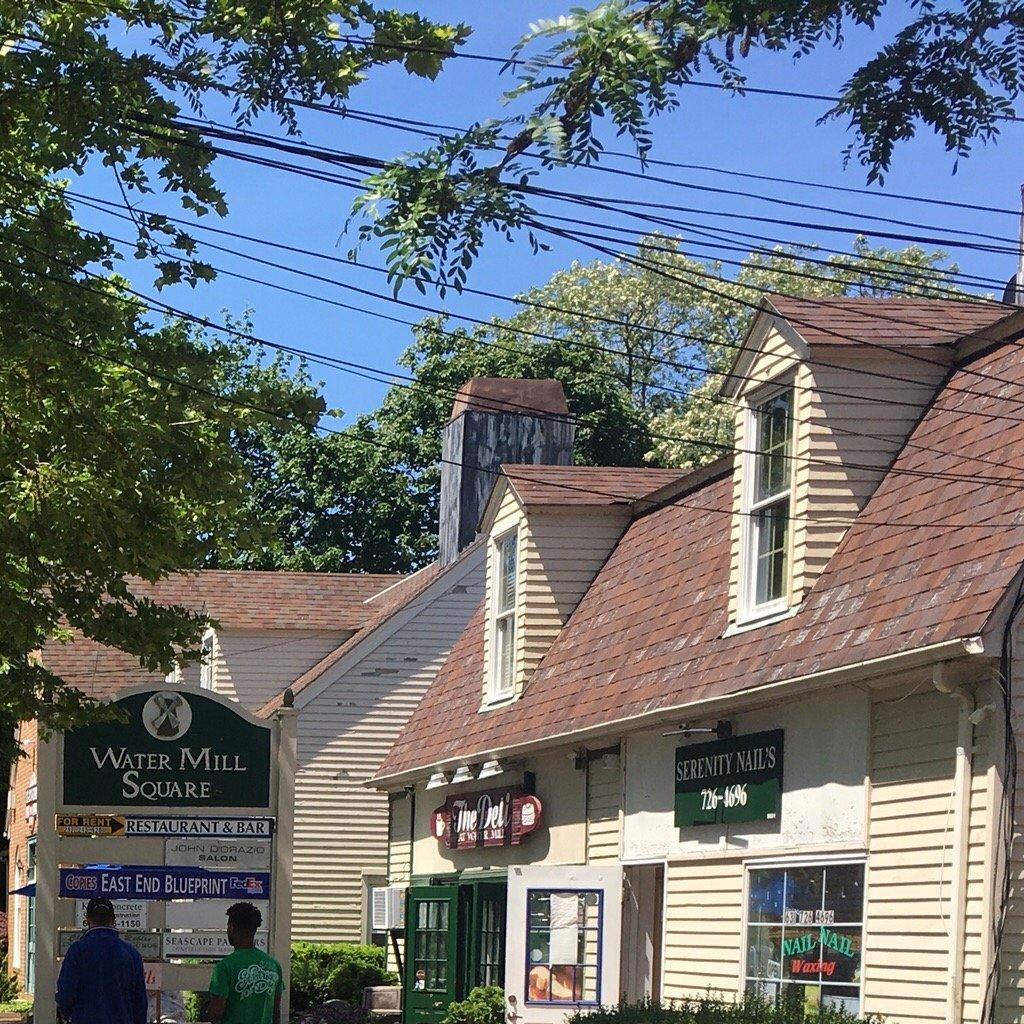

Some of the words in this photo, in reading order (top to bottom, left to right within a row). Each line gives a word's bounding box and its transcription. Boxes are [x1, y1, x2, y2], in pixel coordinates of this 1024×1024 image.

[89, 747, 173, 770] WATER
[179, 747, 247, 771] MILL
[677, 752, 733, 782] SERENITY
[735, 745, 776, 772] NAIL'S
[122, 770, 211, 800] SQUARE
[452, 799, 478, 833] The
[477, 792, 511, 830] Deli
[57, 817, 78, 827] FOR
[82, 817, 111, 827] RENT
[127, 820, 219, 833] RESTAURANT
[222, 820, 233, 833] &
[237, 821, 265, 834] BAR
[171, 844, 205, 853] JOHN
[198, 854, 238, 862] SALON
[65, 873, 98, 890] COPIES
[101, 873, 130, 893] EAST
[135, 874, 161, 893] END
[165, 874, 228, 895] BLUEPRINT
[229, 876, 263, 889] FedEx
[165, 937, 214, 946] SEASCAPE
[783, 933, 816, 956] NAIL
[818, 925, 854, 957] NAIL
[791, 958, 836, 976] Waxing
